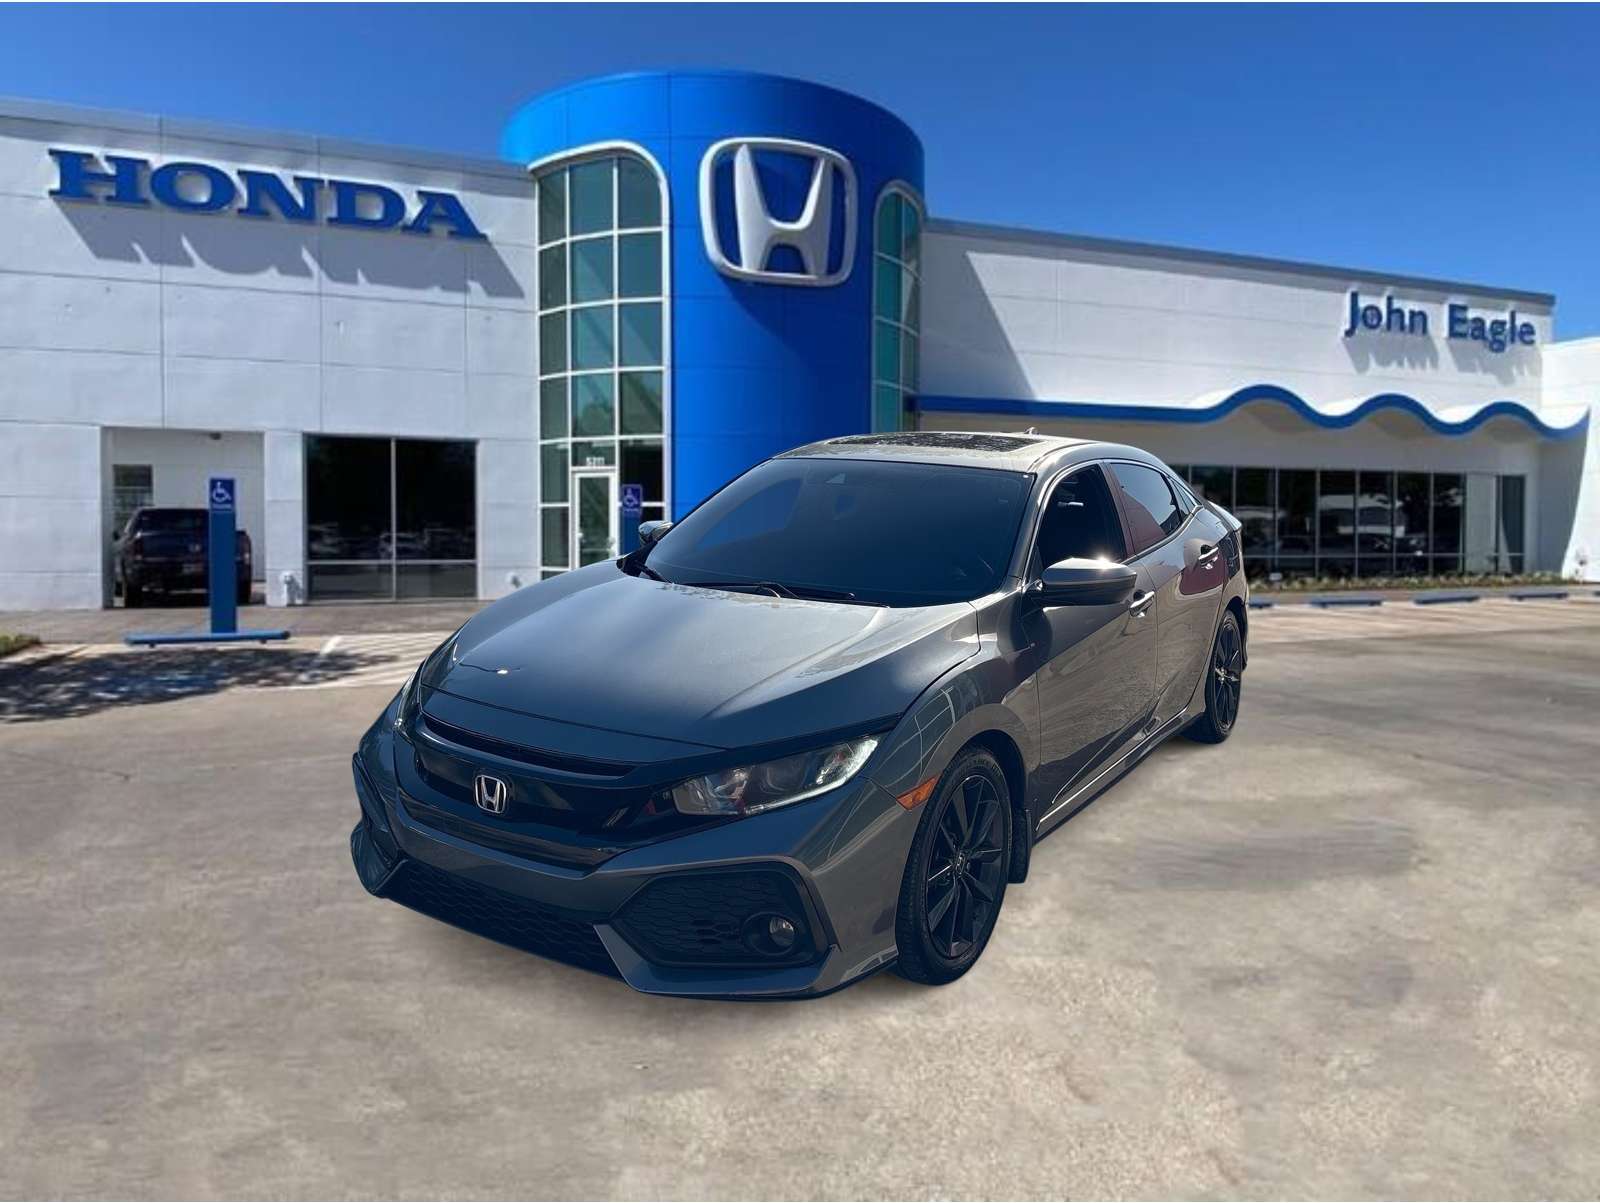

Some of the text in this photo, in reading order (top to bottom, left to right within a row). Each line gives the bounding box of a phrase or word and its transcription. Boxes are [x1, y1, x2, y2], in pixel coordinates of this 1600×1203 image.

[48, 148, 488, 240] HONDA
[1344, 290, 1536, 353] John Eagle
